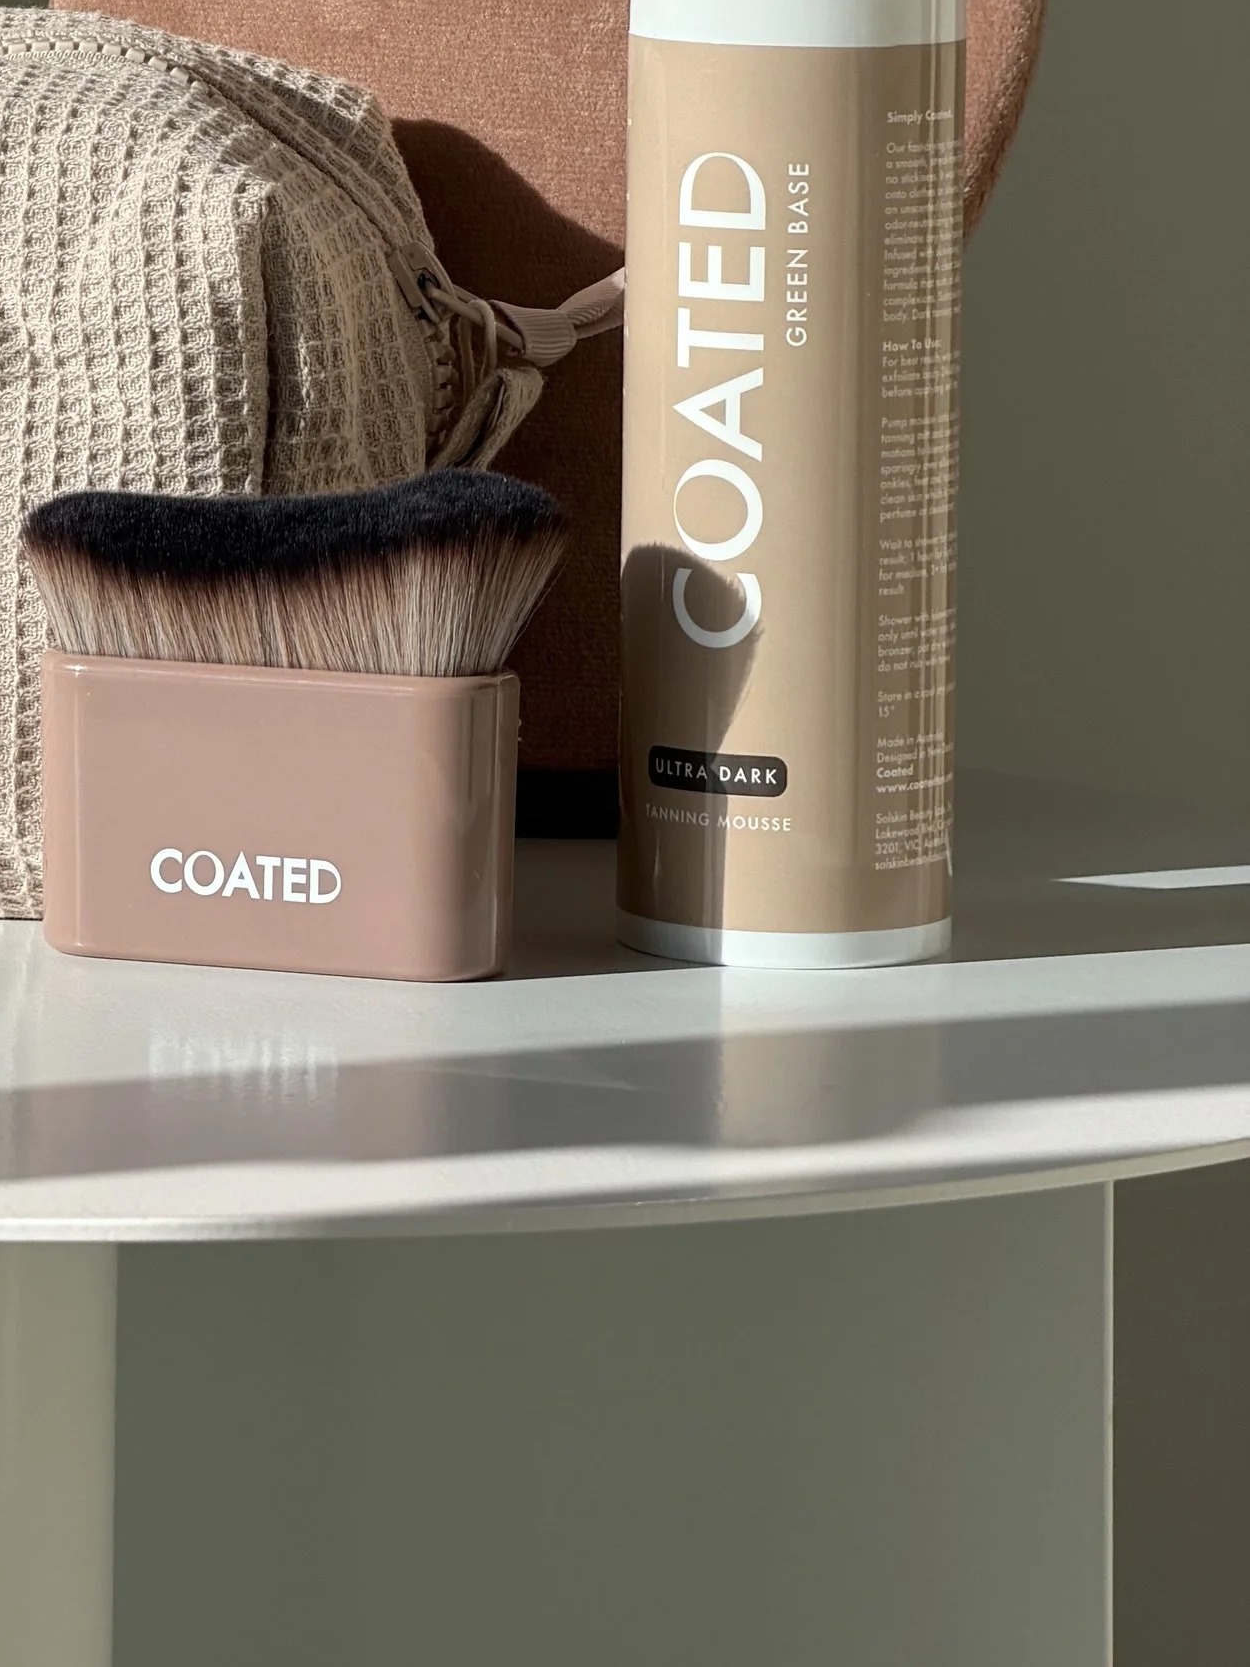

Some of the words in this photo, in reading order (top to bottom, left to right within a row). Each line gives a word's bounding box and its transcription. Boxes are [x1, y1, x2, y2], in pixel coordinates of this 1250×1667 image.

[887, 110, 923, 125] Simply
[787, 162, 810, 234] BASE
[785, 249, 809, 347] GREEN
[882, 340, 909, 352] How
[911, 339, 923, 350] To
[882, 356, 898, 368] For
[672, 151, 766, 648] COATED
[879, 567, 893, 582] for
[878, 660, 891, 672] do
[893, 661, 908, 671] not
[877, 735, 905, 747] Made
[655, 757, 708, 780] ULTRA
[719, 766, 778, 784] DARK
[876, 763, 914, 778] Coated
[645, 803, 710, 826] TANNING
[717, 815, 792, 831] MOUSSE
[150, 847, 342, 904] COATED
